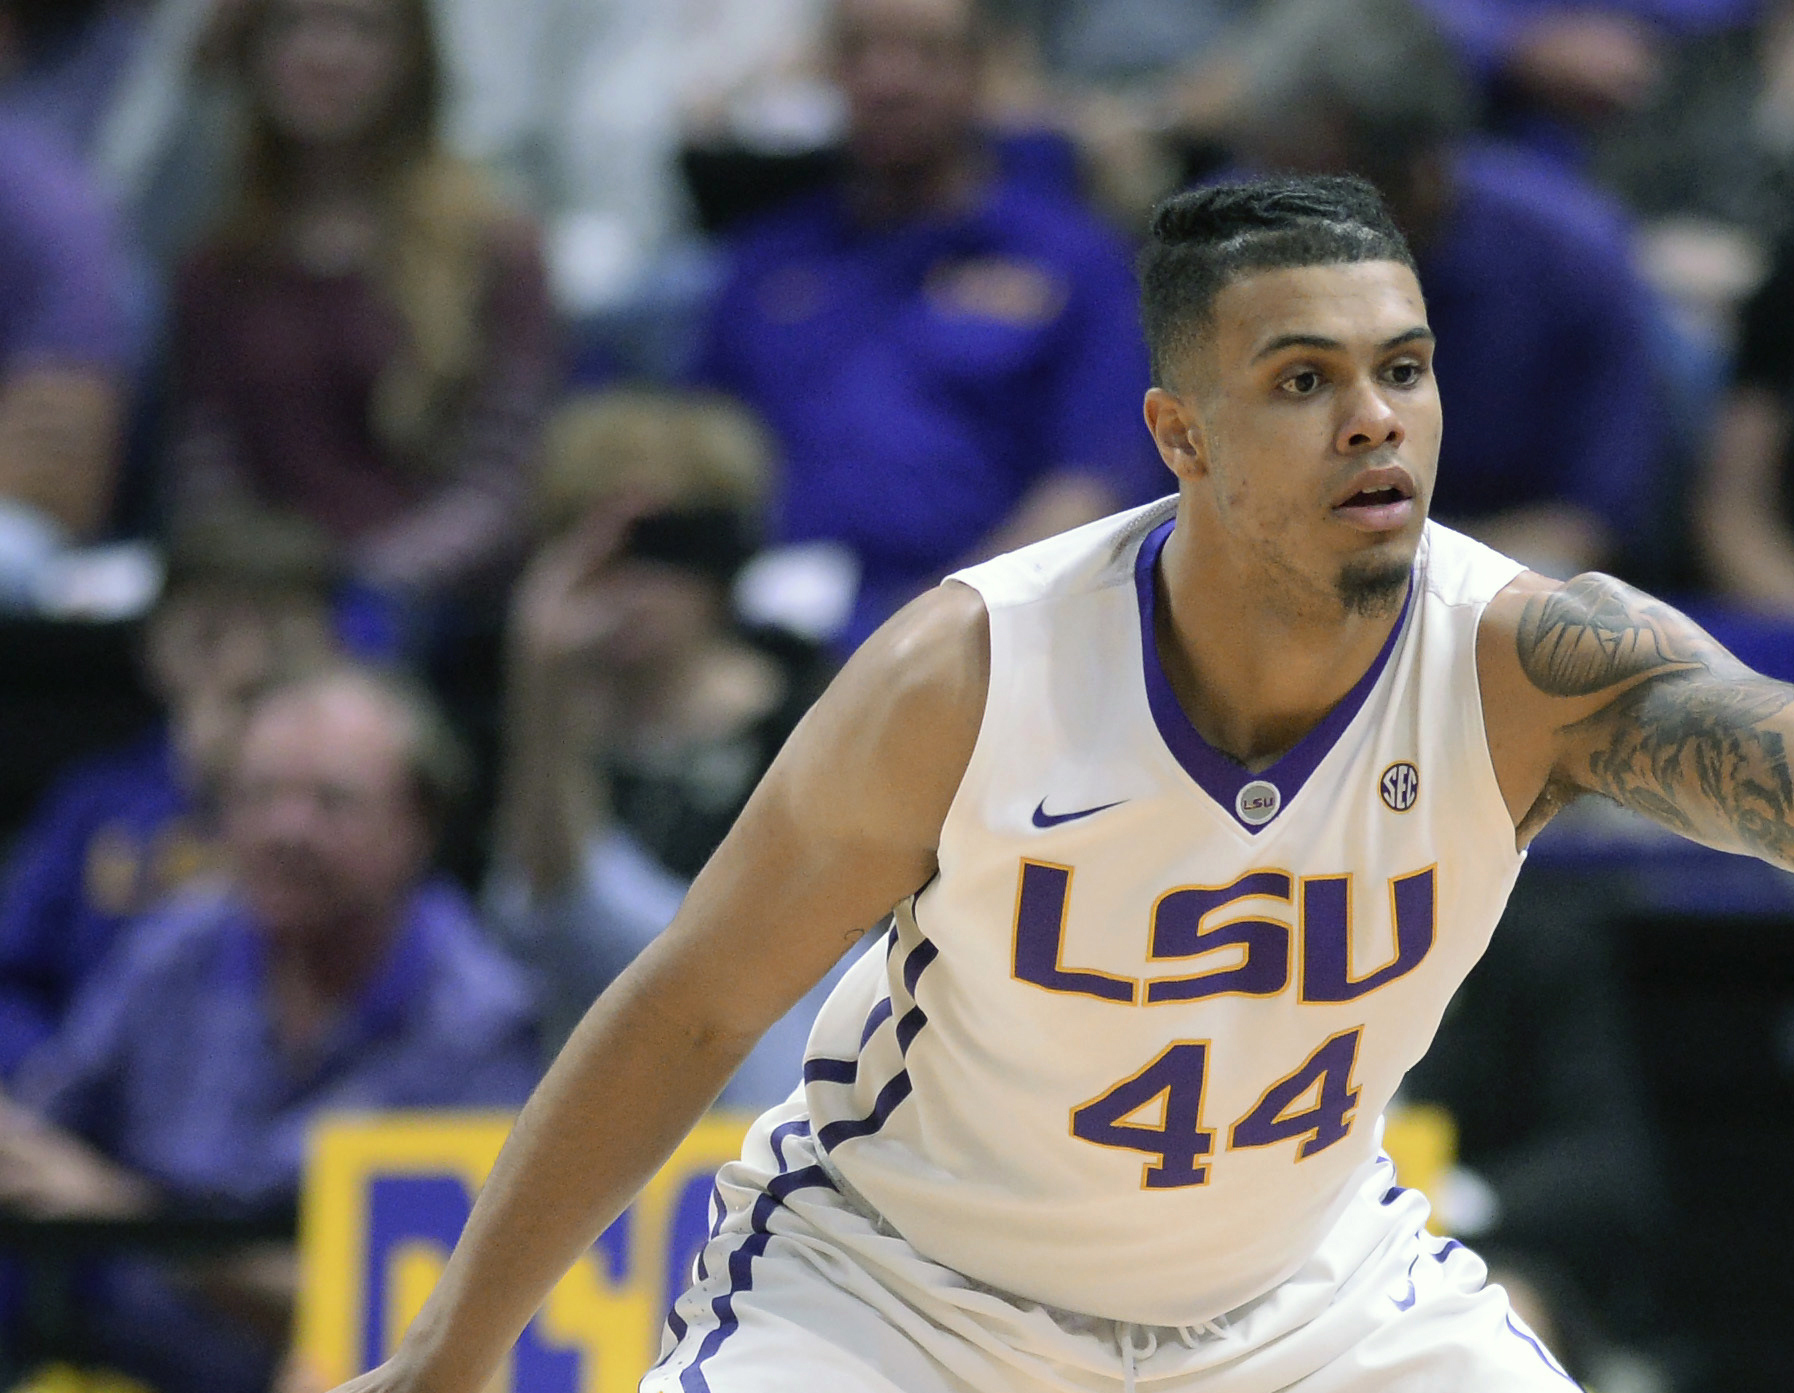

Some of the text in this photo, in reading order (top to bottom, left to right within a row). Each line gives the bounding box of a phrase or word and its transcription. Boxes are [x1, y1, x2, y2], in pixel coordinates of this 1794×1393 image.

[1243, 797, 1275, 811] LSU
[1383, 764, 1417, 809] SEC
[1010, 857, 1438, 1007] LSU
[1068, 1024, 1365, 1191] 44
